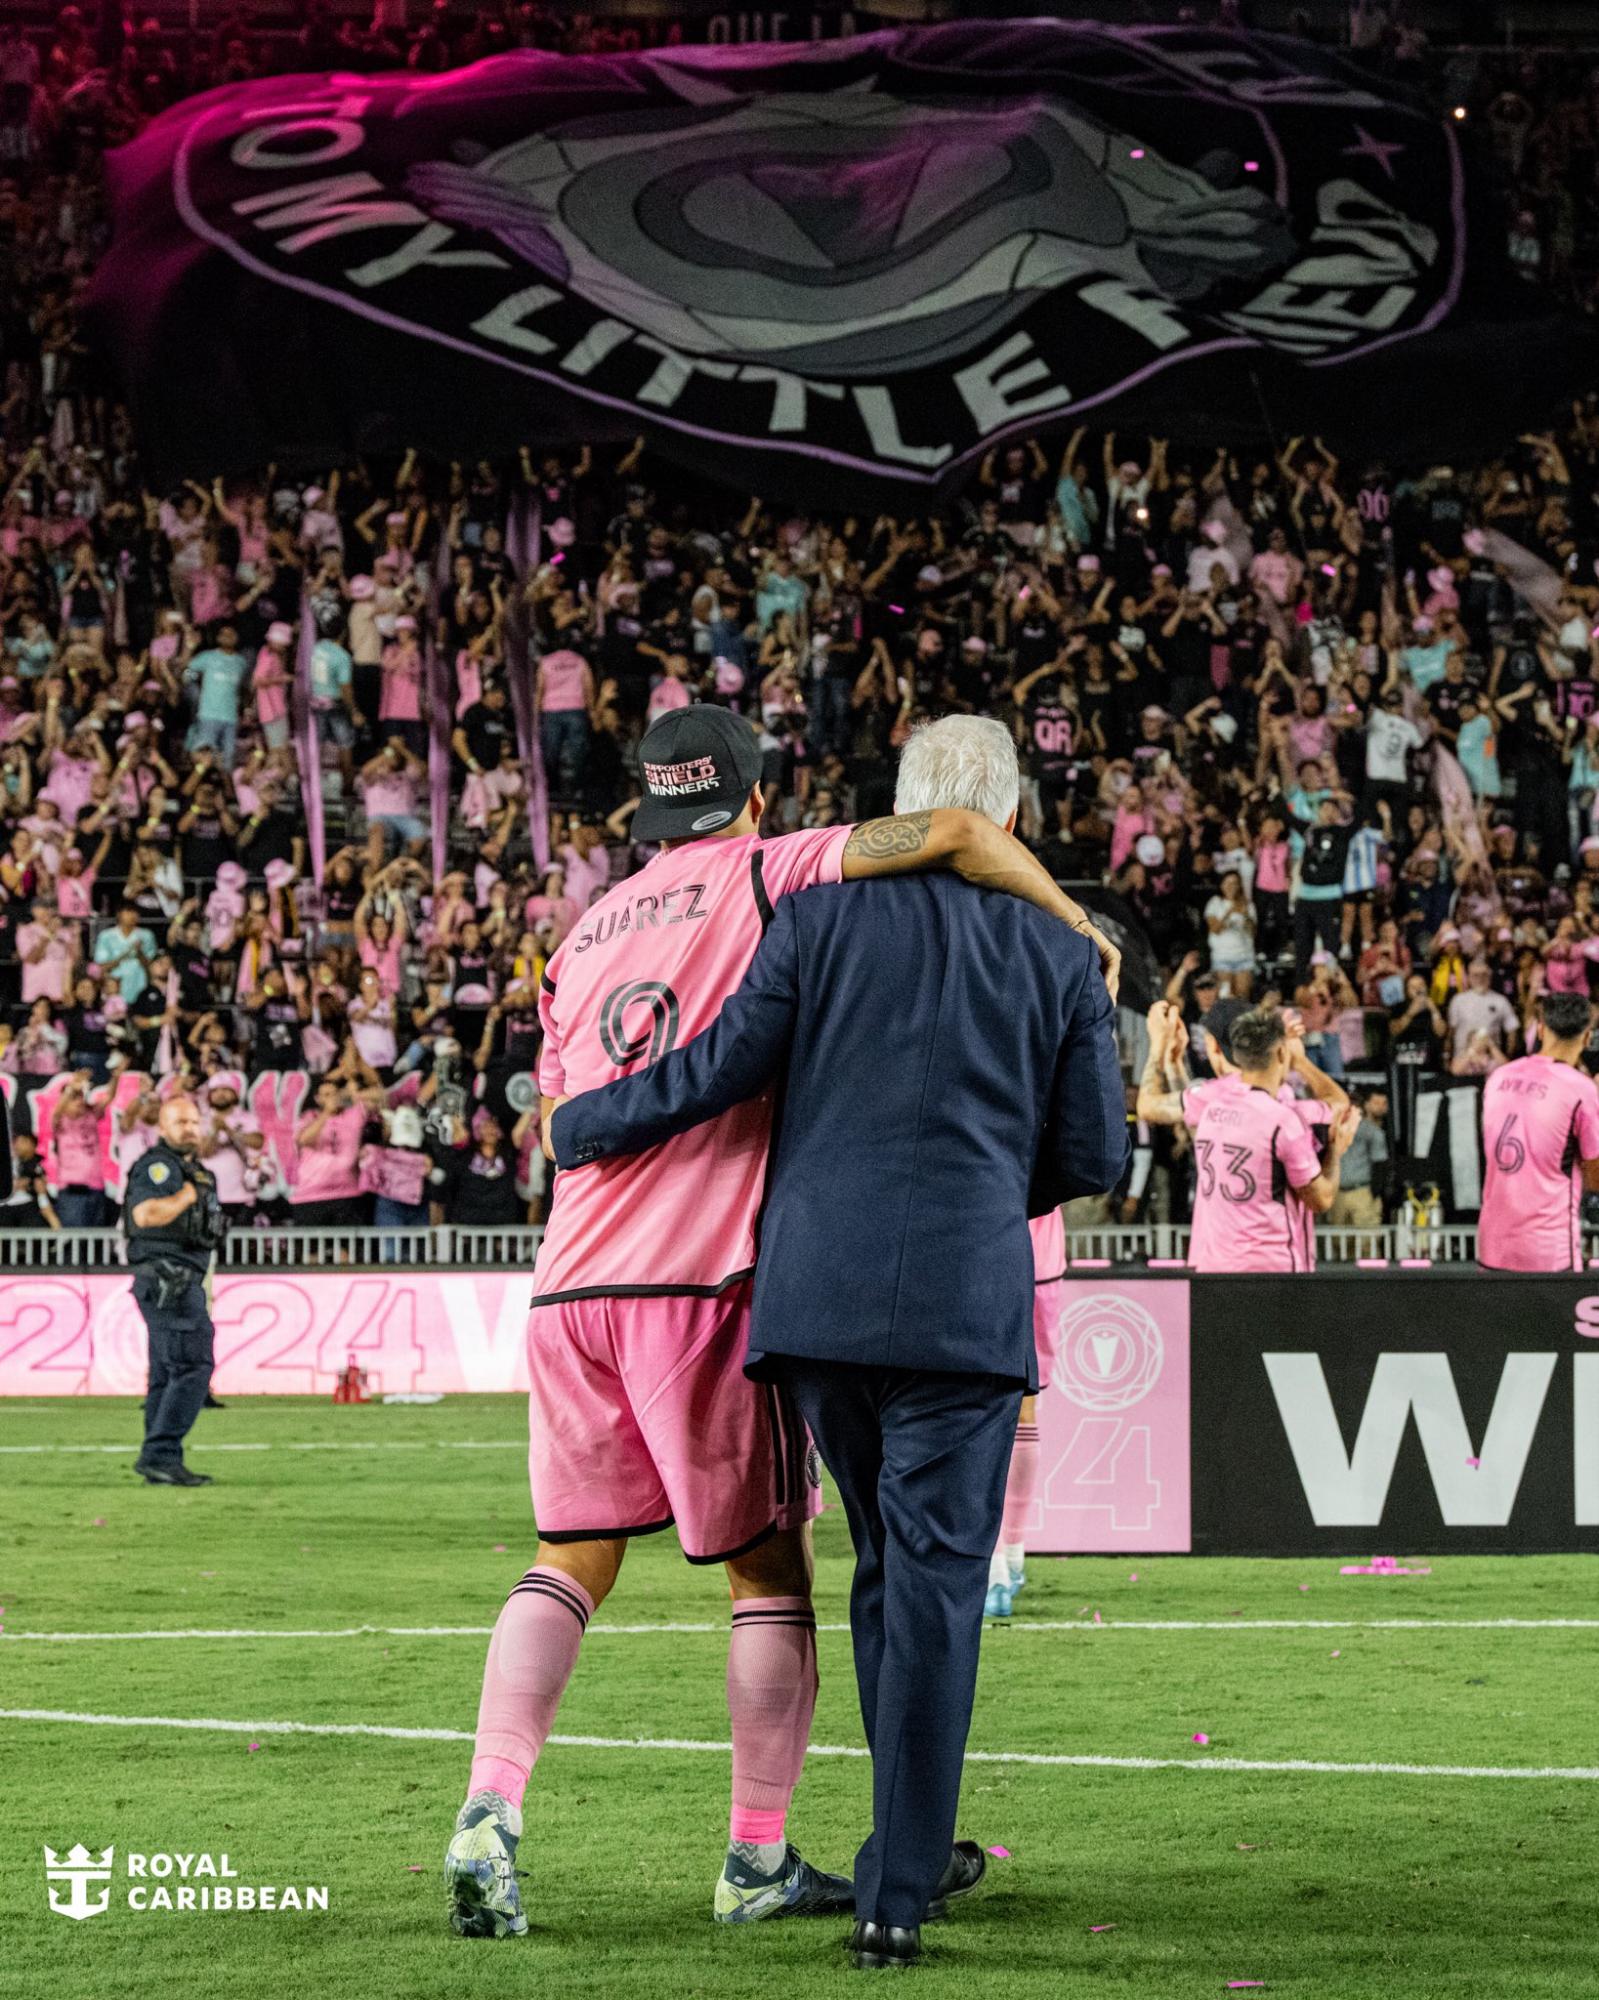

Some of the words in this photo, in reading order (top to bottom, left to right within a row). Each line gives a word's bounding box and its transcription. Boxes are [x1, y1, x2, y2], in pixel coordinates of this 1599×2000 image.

[231, 170, 514, 288] MY
[469, 283, 1072, 467] LITTLE
[645, 764, 716, 786] SHIELD
[648, 776, 722, 797] WINNERS
[574, 884, 709, 953] SUÁREZ
[600, 977, 680, 1068] 9
[1196, 1139, 1256, 1204] 33
[1494, 1112, 1525, 1175] 6
